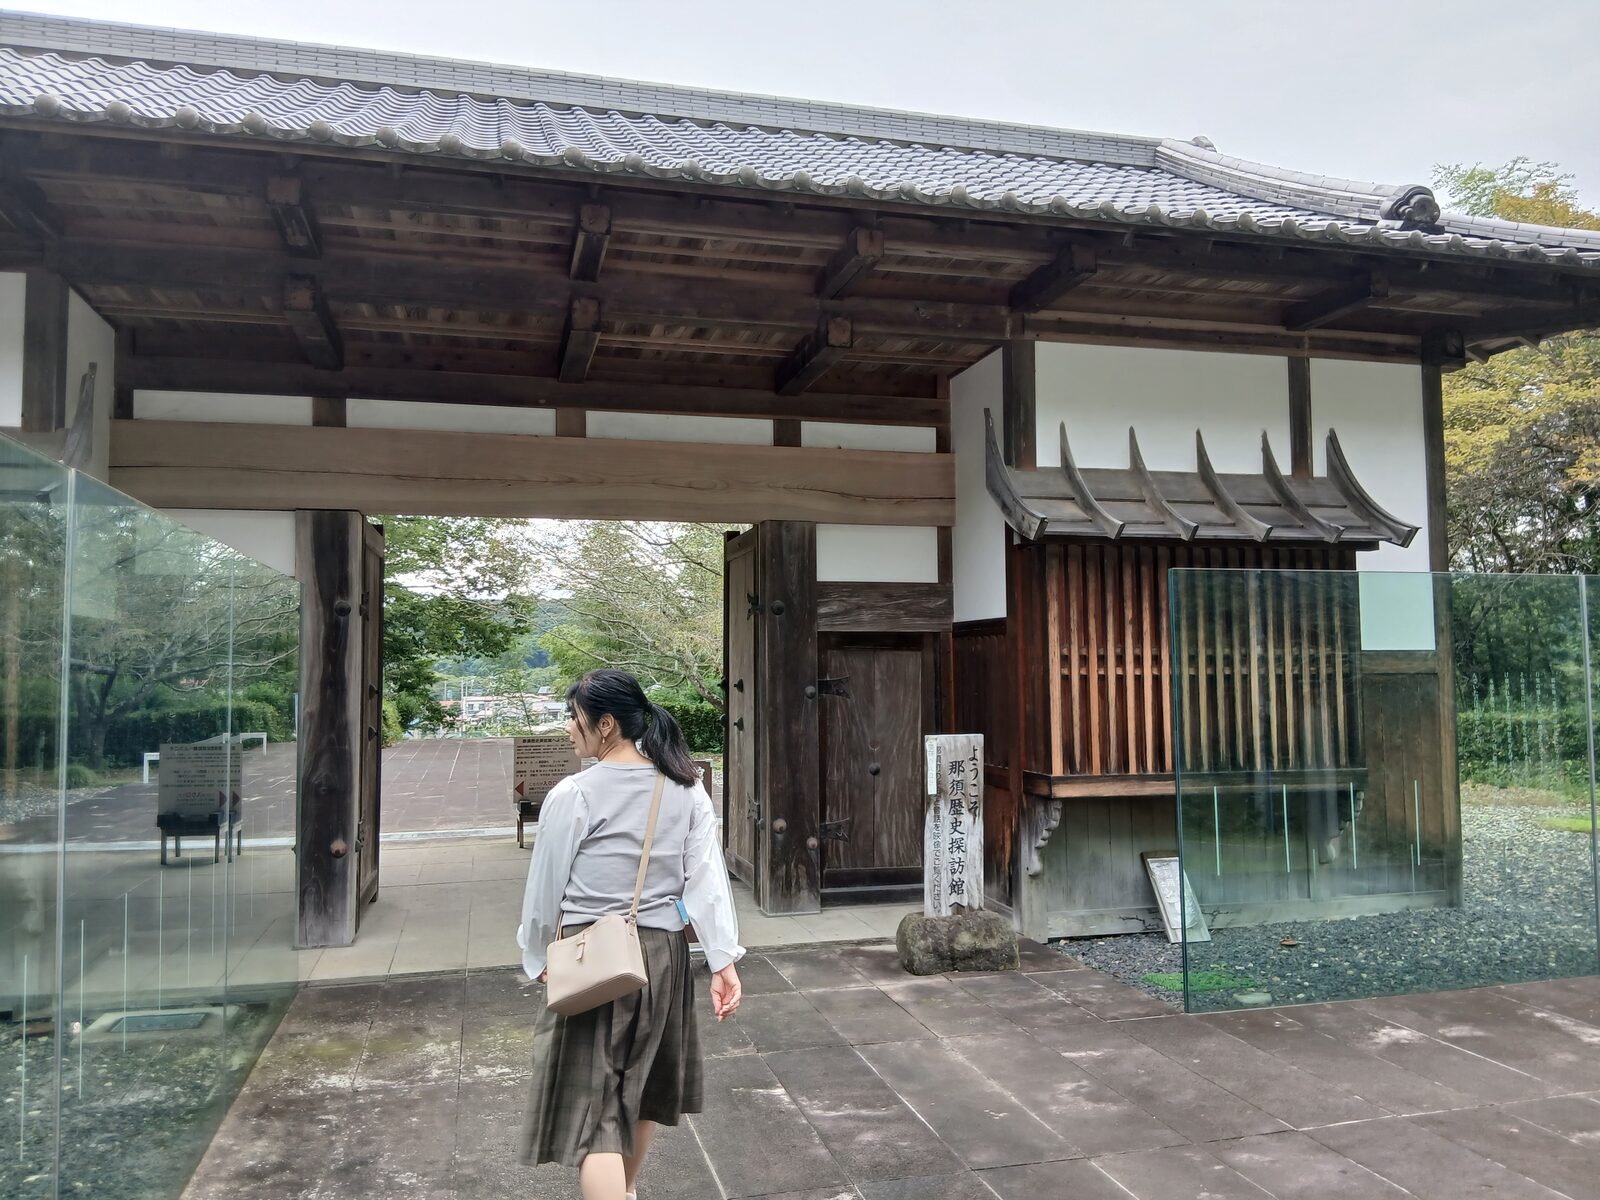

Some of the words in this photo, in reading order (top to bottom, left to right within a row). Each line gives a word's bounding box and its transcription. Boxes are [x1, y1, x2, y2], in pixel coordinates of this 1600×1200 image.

[948, 760, 966, 909] 那須歴史探訪館へ
[968, 745, 980, 817] ようこそ
